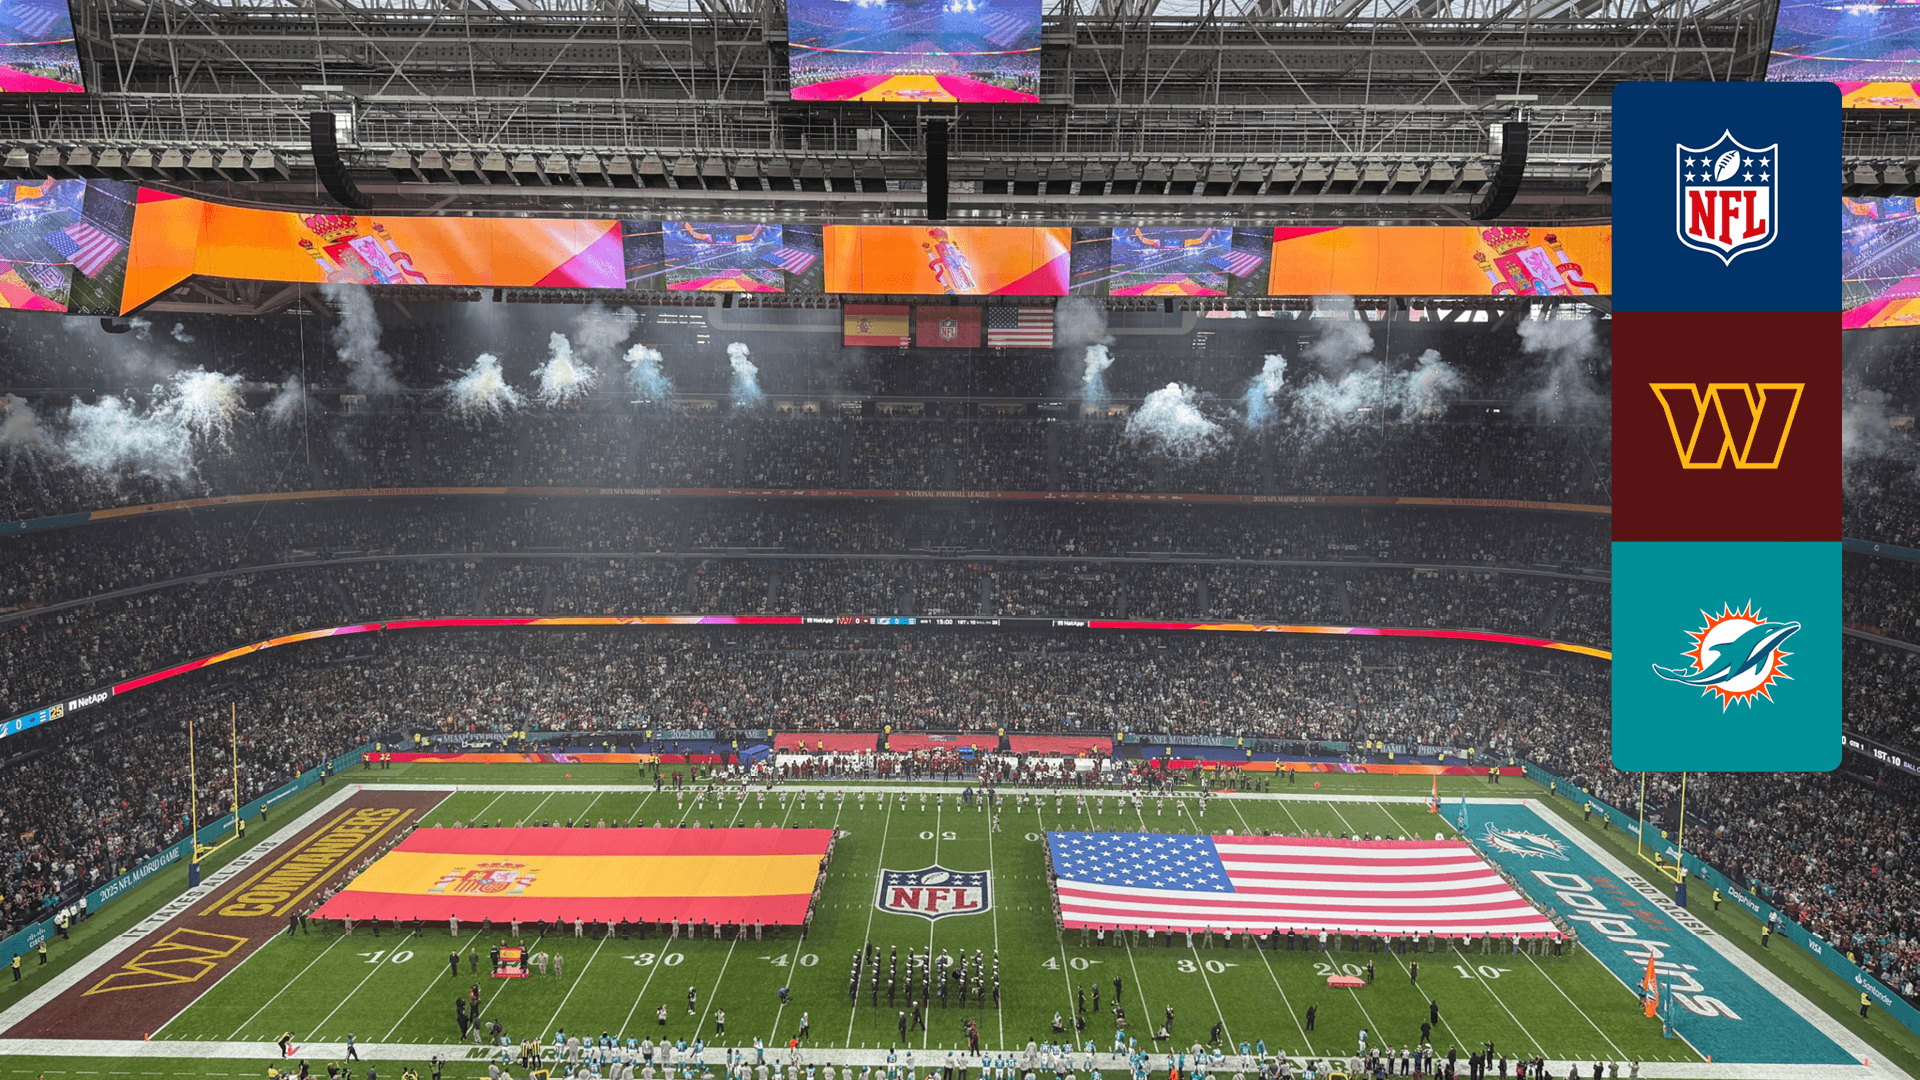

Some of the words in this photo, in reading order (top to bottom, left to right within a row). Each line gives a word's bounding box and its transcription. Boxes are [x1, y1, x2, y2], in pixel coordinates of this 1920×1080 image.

[78, 692, 108, 708] NetApp
[15, 719, 22, 731] 0
[671, 731, 690, 739] 2025
[691, 731, 705, 739] NFL
[1873, 748, 1888, 761] 1ST
[1891, 756, 1901, 767] 10
[1903, 761, 1916, 772] BALL
[919, 831, 957, 840] 50
[218, 808, 401, 917] COMMANDERS
[100, 882, 119, 903] 2025
[119, 876, 132, 890] NFL
[132, 858, 160, 884] MADRID
[160, 847, 180, 866] GAME
[122, 928, 150, 938] IT
[145, 890, 206, 924] TAKES
[201, 869, 237, 887] ALL
[232, 855, 255, 867] OF
[256, 841, 278, 852] US
[889, 887, 978, 913] NFL
[1623, 876, 1658, 895] END
[1650, 897, 1718, 936] RACISM
[1727, 886, 1760, 913] Dolphins
[1529, 870, 1743, 1021] Dolphins
[1808, 938, 1822, 956] VISA
[364, 950, 415, 964] 10
[633, 952, 685, 967] 30
[770, 953, 820, 968] 40
[1041, 956, 1090, 971] 40
[1177, 959, 1226, 974] 30
[1313, 962, 1364, 978] 20
[1453, 964, 1501, 979] 10
[1862, 979, 1893, 1007] Santander
